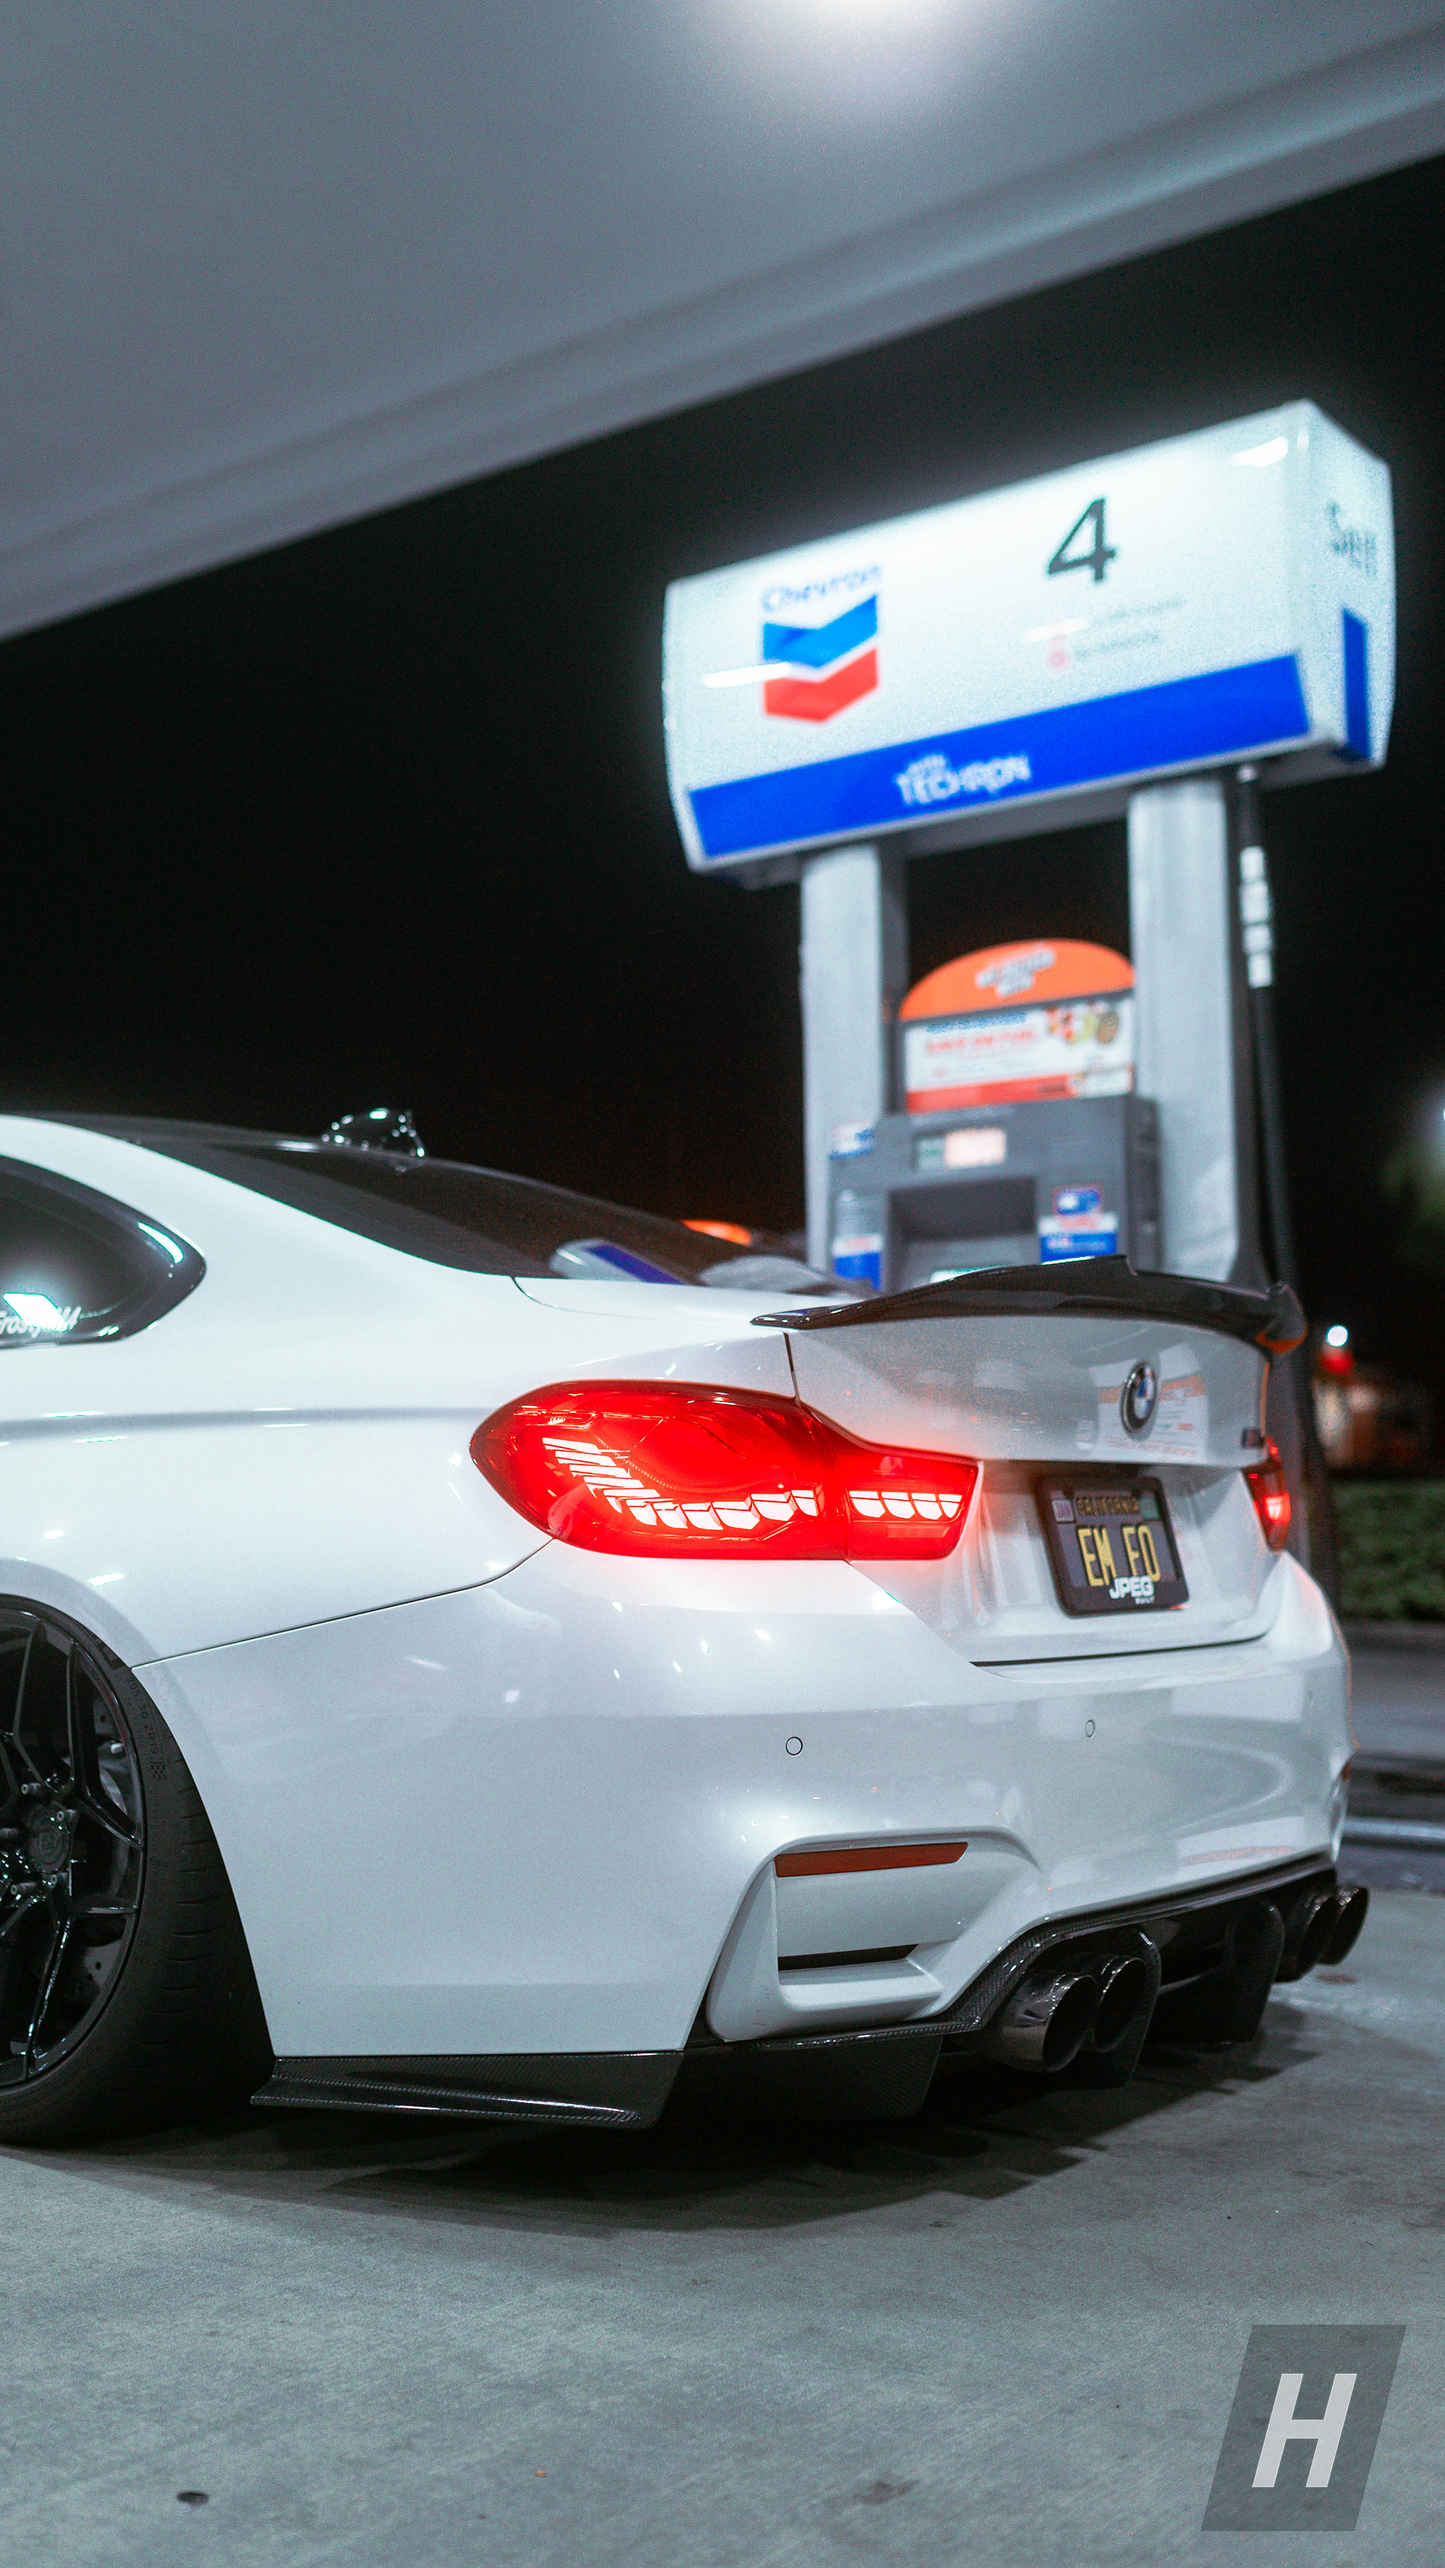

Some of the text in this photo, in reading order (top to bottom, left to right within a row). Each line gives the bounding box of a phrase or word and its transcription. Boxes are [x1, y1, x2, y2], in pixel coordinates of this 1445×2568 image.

[1047, 496, 1118, 584] 4
[760, 564, 882, 613] Chevron
[1077, 1497, 1140, 1515] CALIFORNIA
[1077, 1526, 1118, 1587] EM
[1109, 1576, 1154, 1599] JPEG
